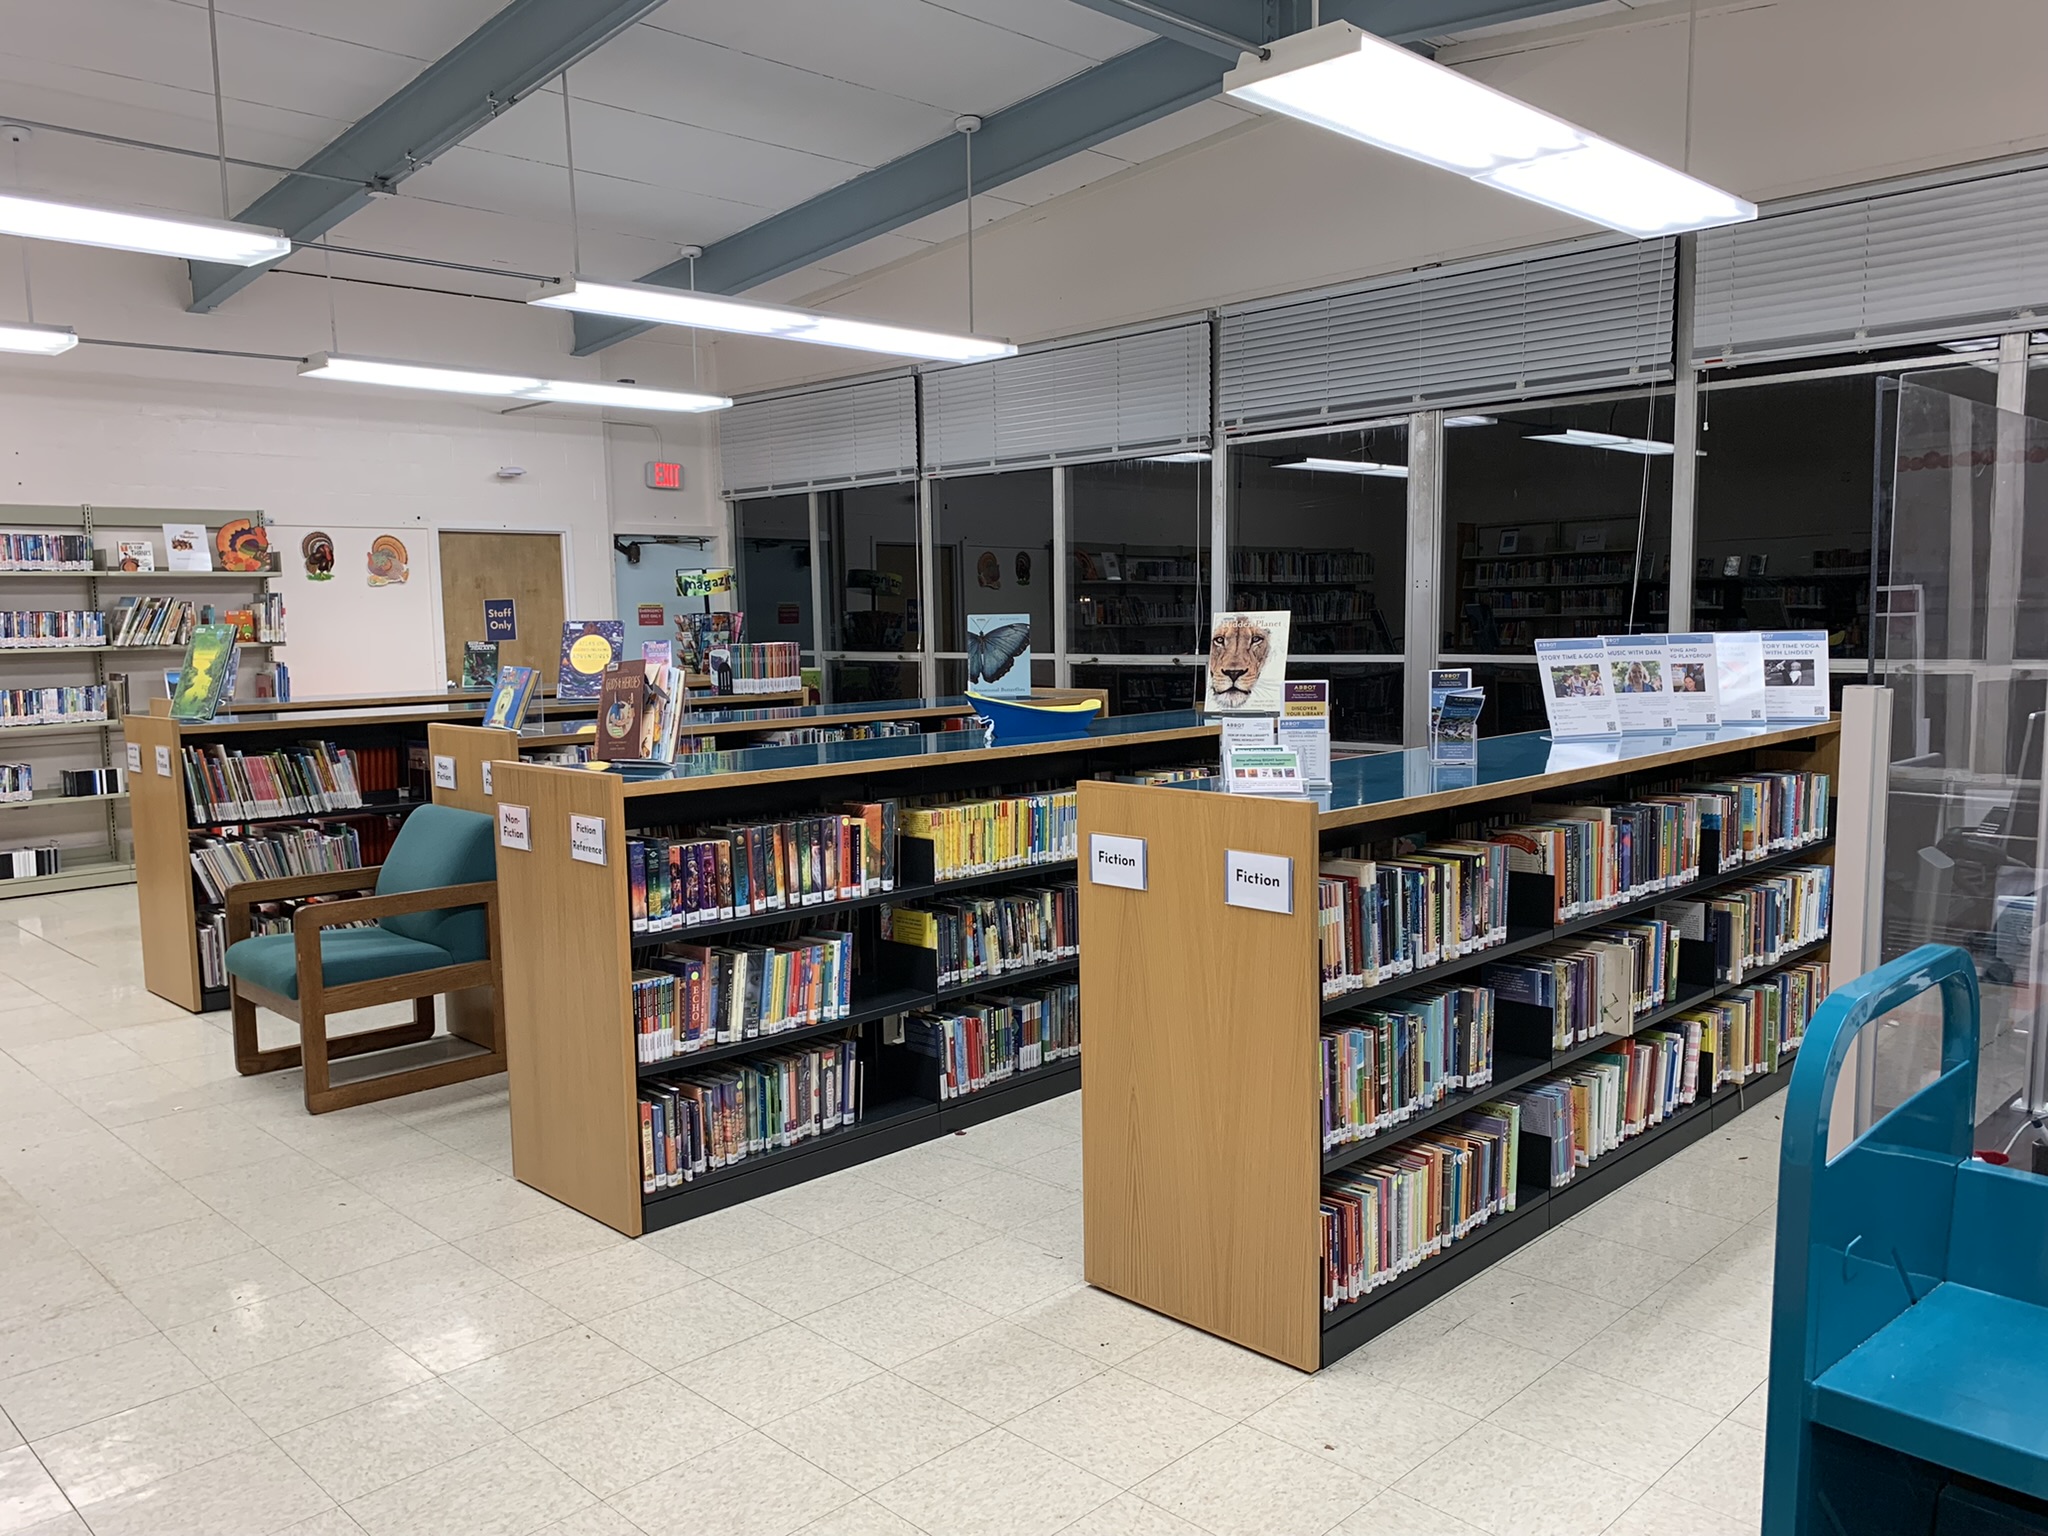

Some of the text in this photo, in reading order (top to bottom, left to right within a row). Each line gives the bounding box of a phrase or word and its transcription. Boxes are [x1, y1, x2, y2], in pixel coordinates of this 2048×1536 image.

[656, 463, 680, 487] EXIT
[488, 608, 512, 618] Staff
[490, 620, 512, 631] Only
[1256, 619, 1282, 627] Planet
[437, 772, 452, 782] Fiction
[505, 813, 520, 825] Non-
[503, 826, 524, 840] Fiction
[576, 822, 597, 836] Fiction
[573, 840, 602, 855] Reference
[1098, 850, 1135, 867] Fiction
[1236, 869, 1280, 888] Fiction
